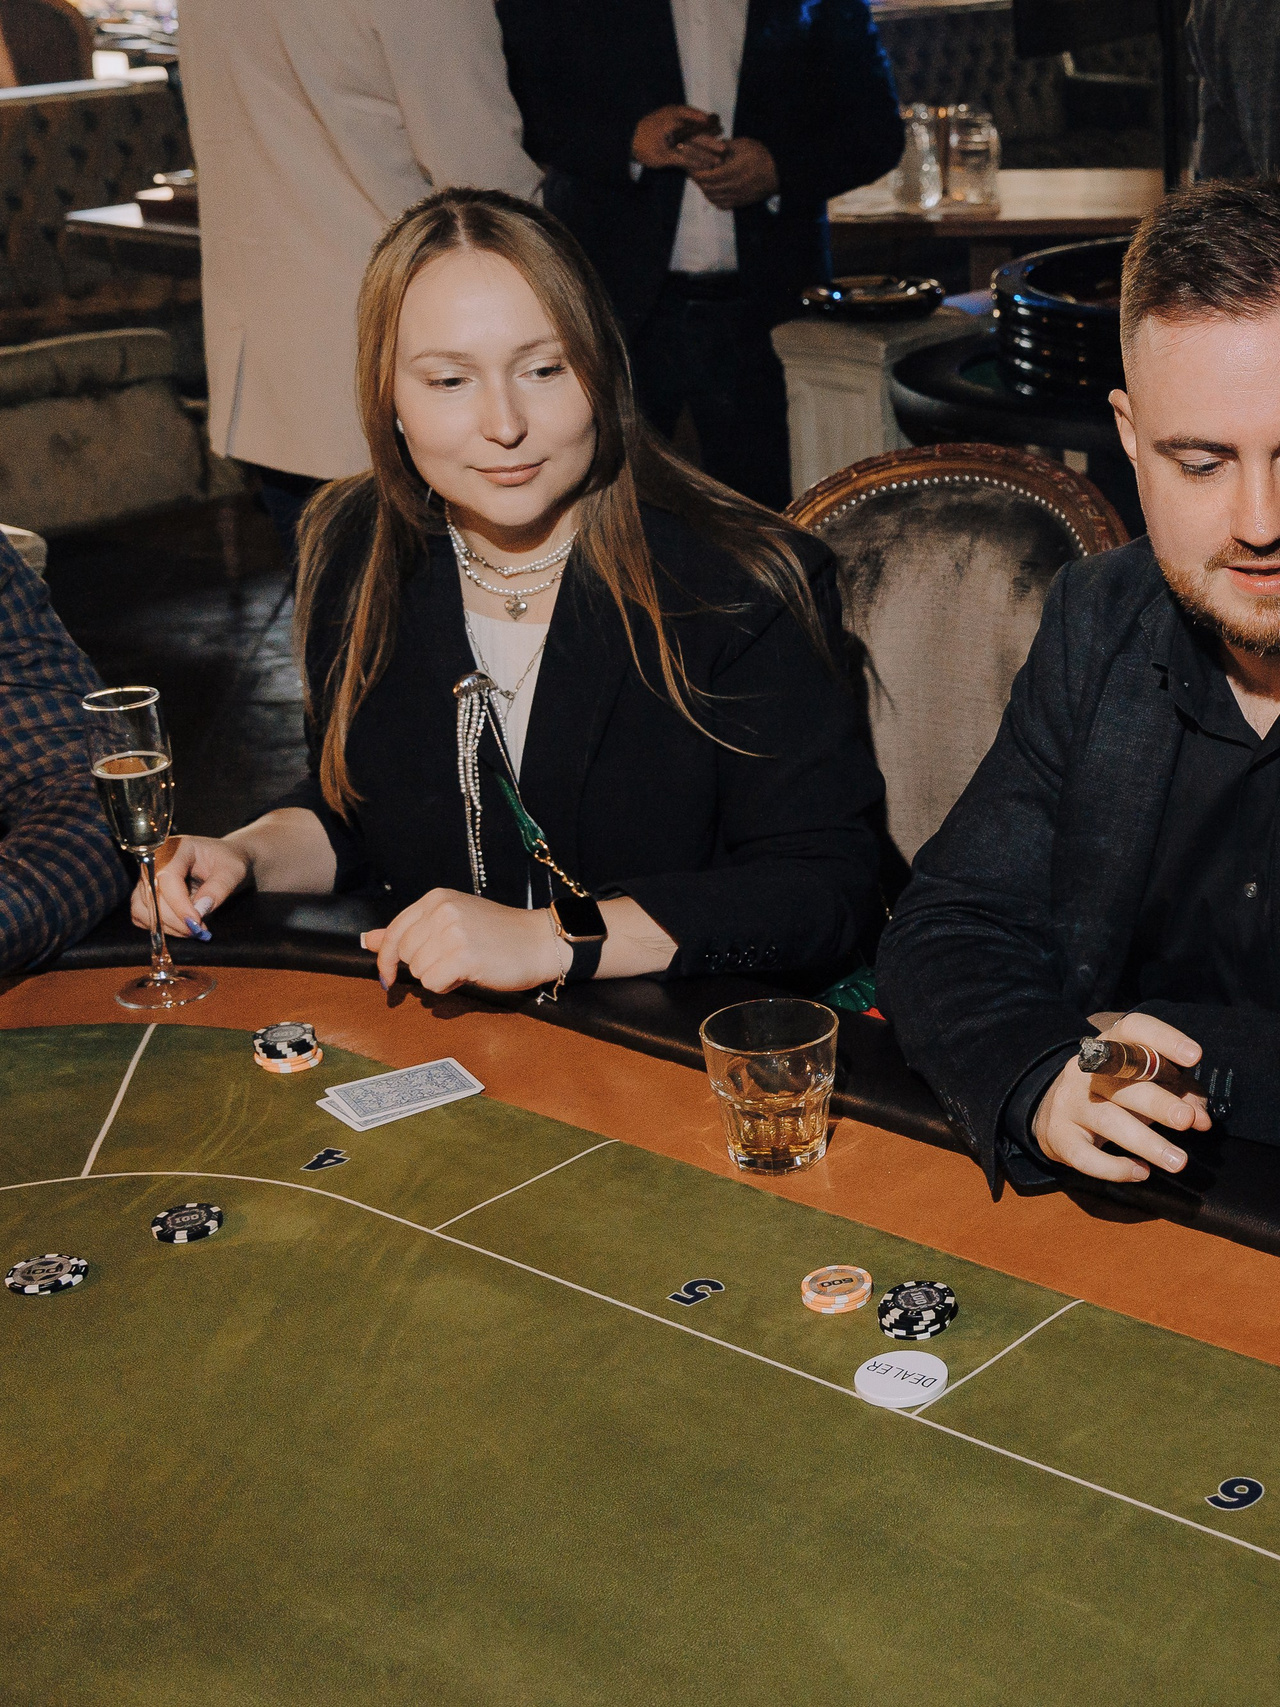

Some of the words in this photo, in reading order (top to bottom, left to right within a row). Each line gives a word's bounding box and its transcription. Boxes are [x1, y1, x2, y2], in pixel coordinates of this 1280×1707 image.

[300, 1147, 351, 1172] 4
[174, 1213, 200, 1224] 100
[26, 1267, 60, 1275] 100
[820, 1277, 854, 1288] 500
[666, 1278, 725, 1307] 5
[911, 1290, 928, 1306] 100
[866, 1361, 938, 1389] DEALER
